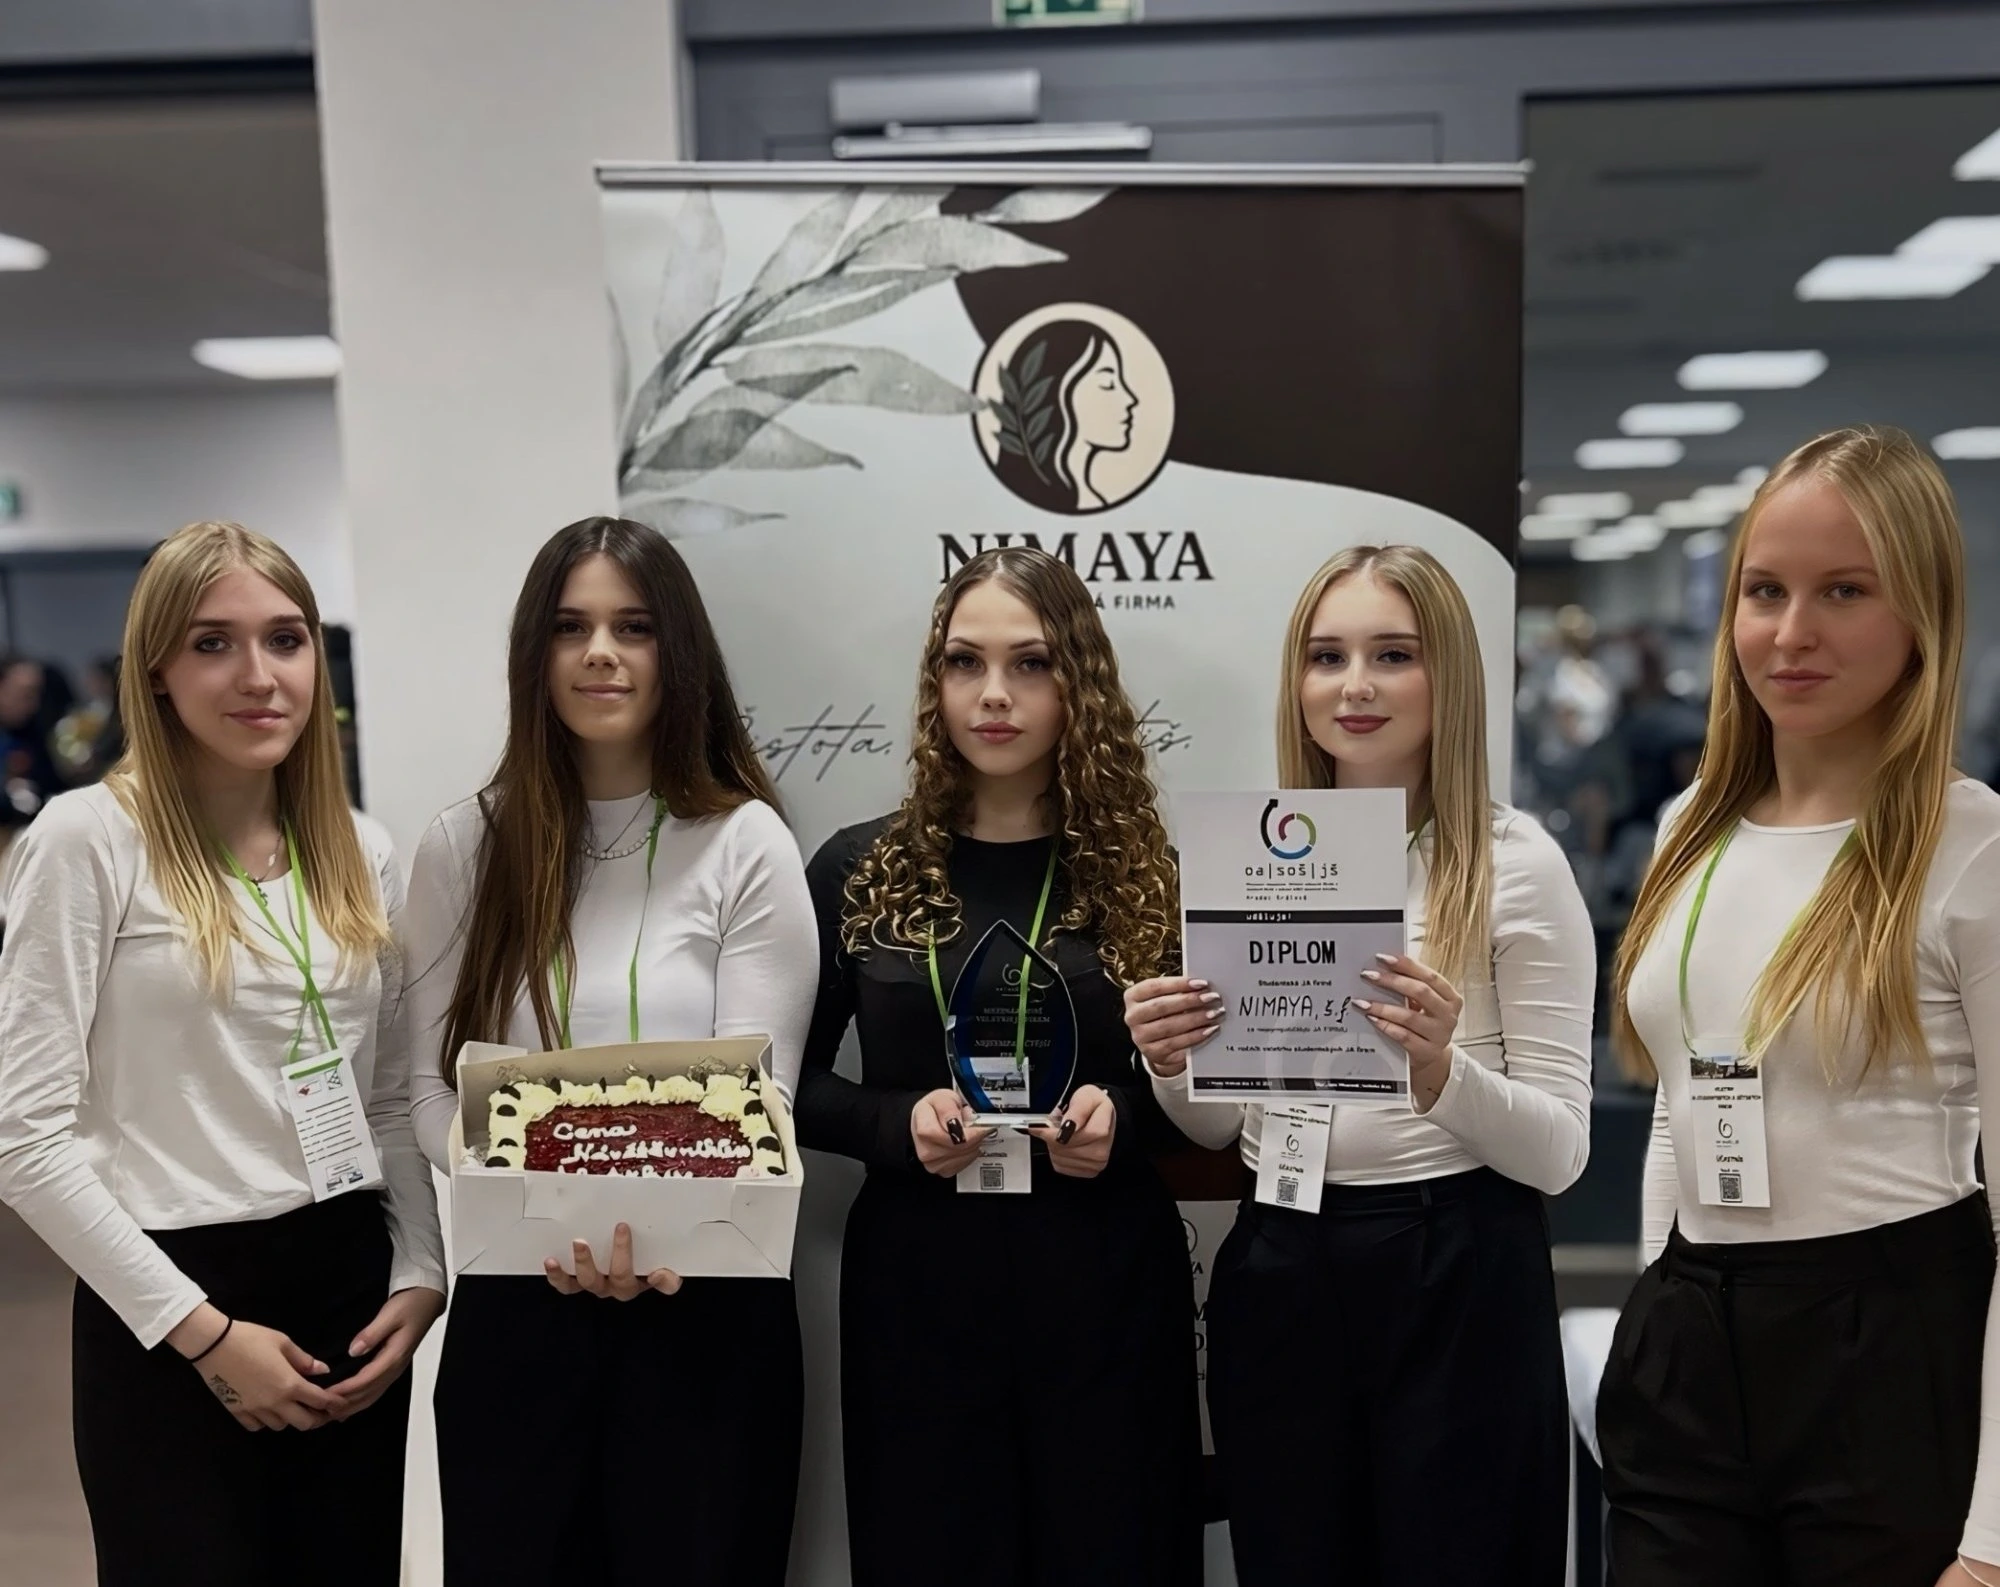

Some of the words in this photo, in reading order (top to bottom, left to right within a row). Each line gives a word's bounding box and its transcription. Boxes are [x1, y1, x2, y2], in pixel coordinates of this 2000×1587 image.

[938, 531, 1214, 584] NMAYA
[1114, 595, 1175, 610] FIRMA
[1249, 941, 1336, 964] DIPLOM
[1239, 995, 1318, 1021] NIMAYA,
